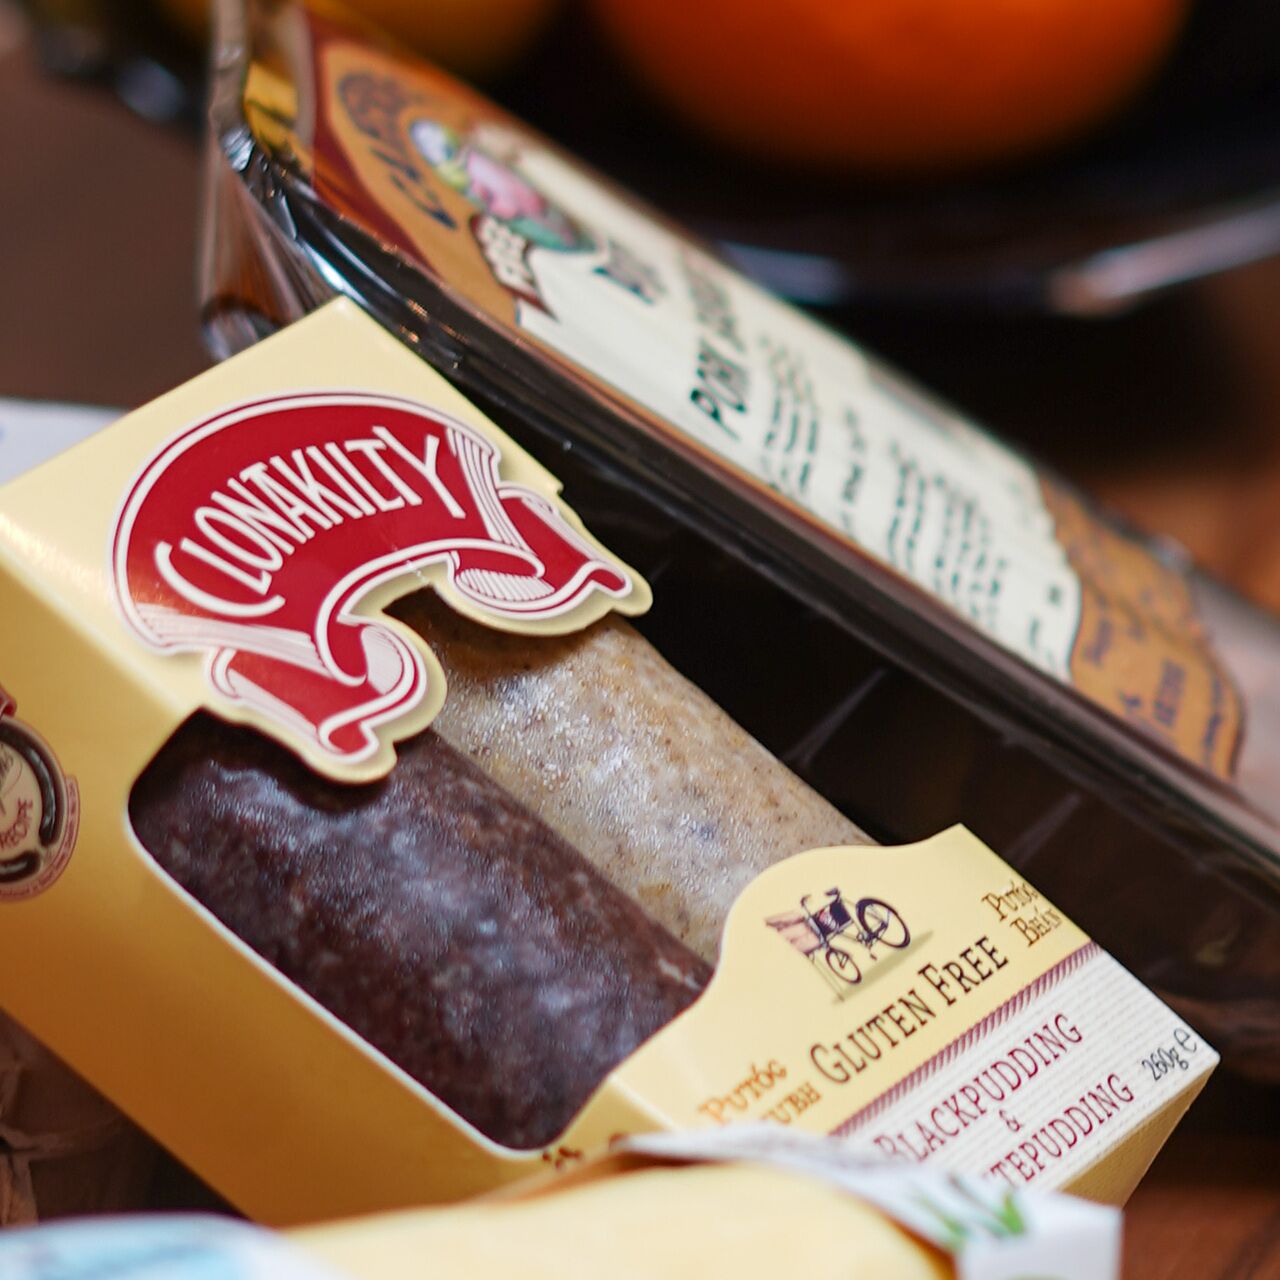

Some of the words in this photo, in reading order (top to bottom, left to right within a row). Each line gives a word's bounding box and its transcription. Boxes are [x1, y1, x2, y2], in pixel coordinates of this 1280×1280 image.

[154, 425, 466, 617] CLONAKILTY
[809, 988, 940, 1085] GLUTEN
[917, 935, 1010, 1009] FREE
[766, 1082, 822, 1125] UBH
[873, 1013, 1084, 1164] BLACKPUDDING
[985, 1073, 1135, 1188] TEPUDDING
[1141, 1044, 1189, 1082] 260g
[999, 1109, 1025, 1134] &
